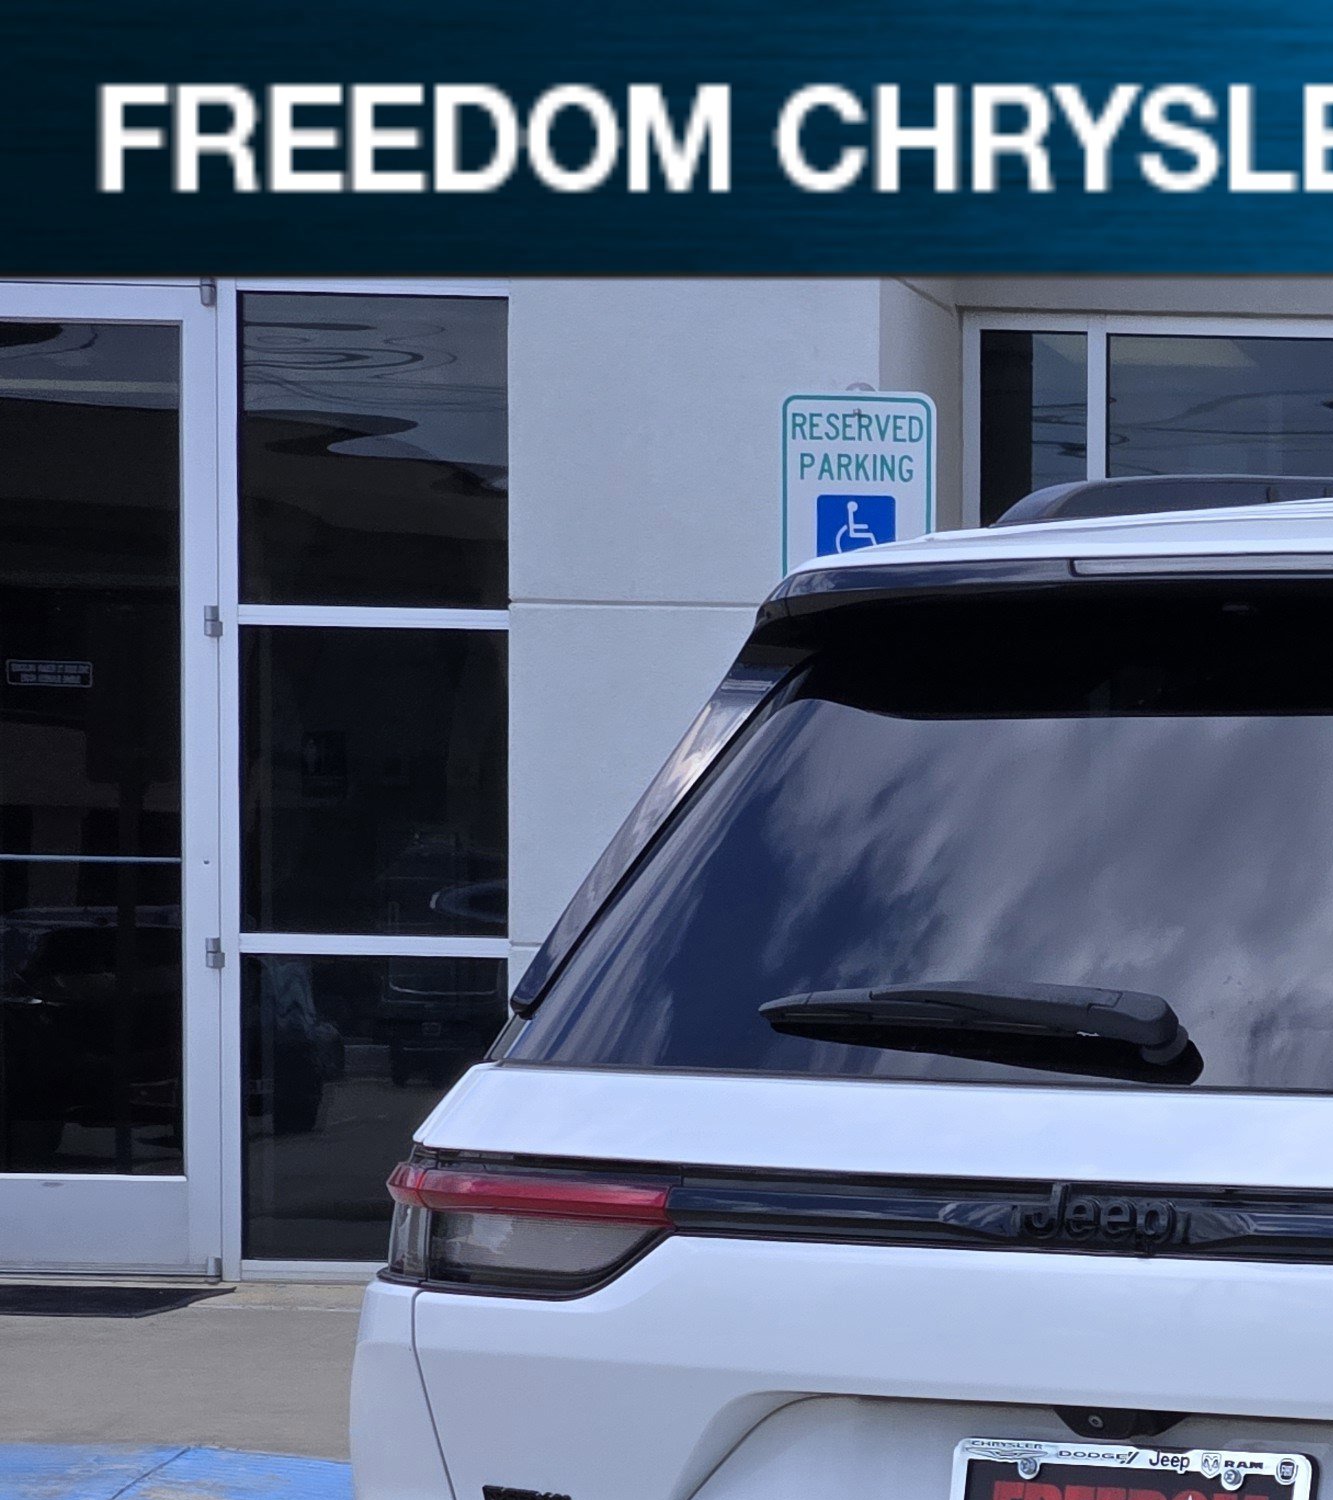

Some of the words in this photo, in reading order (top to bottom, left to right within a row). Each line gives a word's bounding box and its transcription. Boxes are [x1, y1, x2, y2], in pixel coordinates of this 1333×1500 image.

[791, 413, 923, 443] RESERVED
[799, 452, 914, 482] PARKING
[1018, 1181, 1178, 1257] Jeep
[971, 1439, 1043, 1450] CHRYSLER
[1059, 1449, 1128, 1461] DODGE
[1148, 1451, 1191, 1472] Jeep
[1224, 1459, 1264, 1470] RAM
